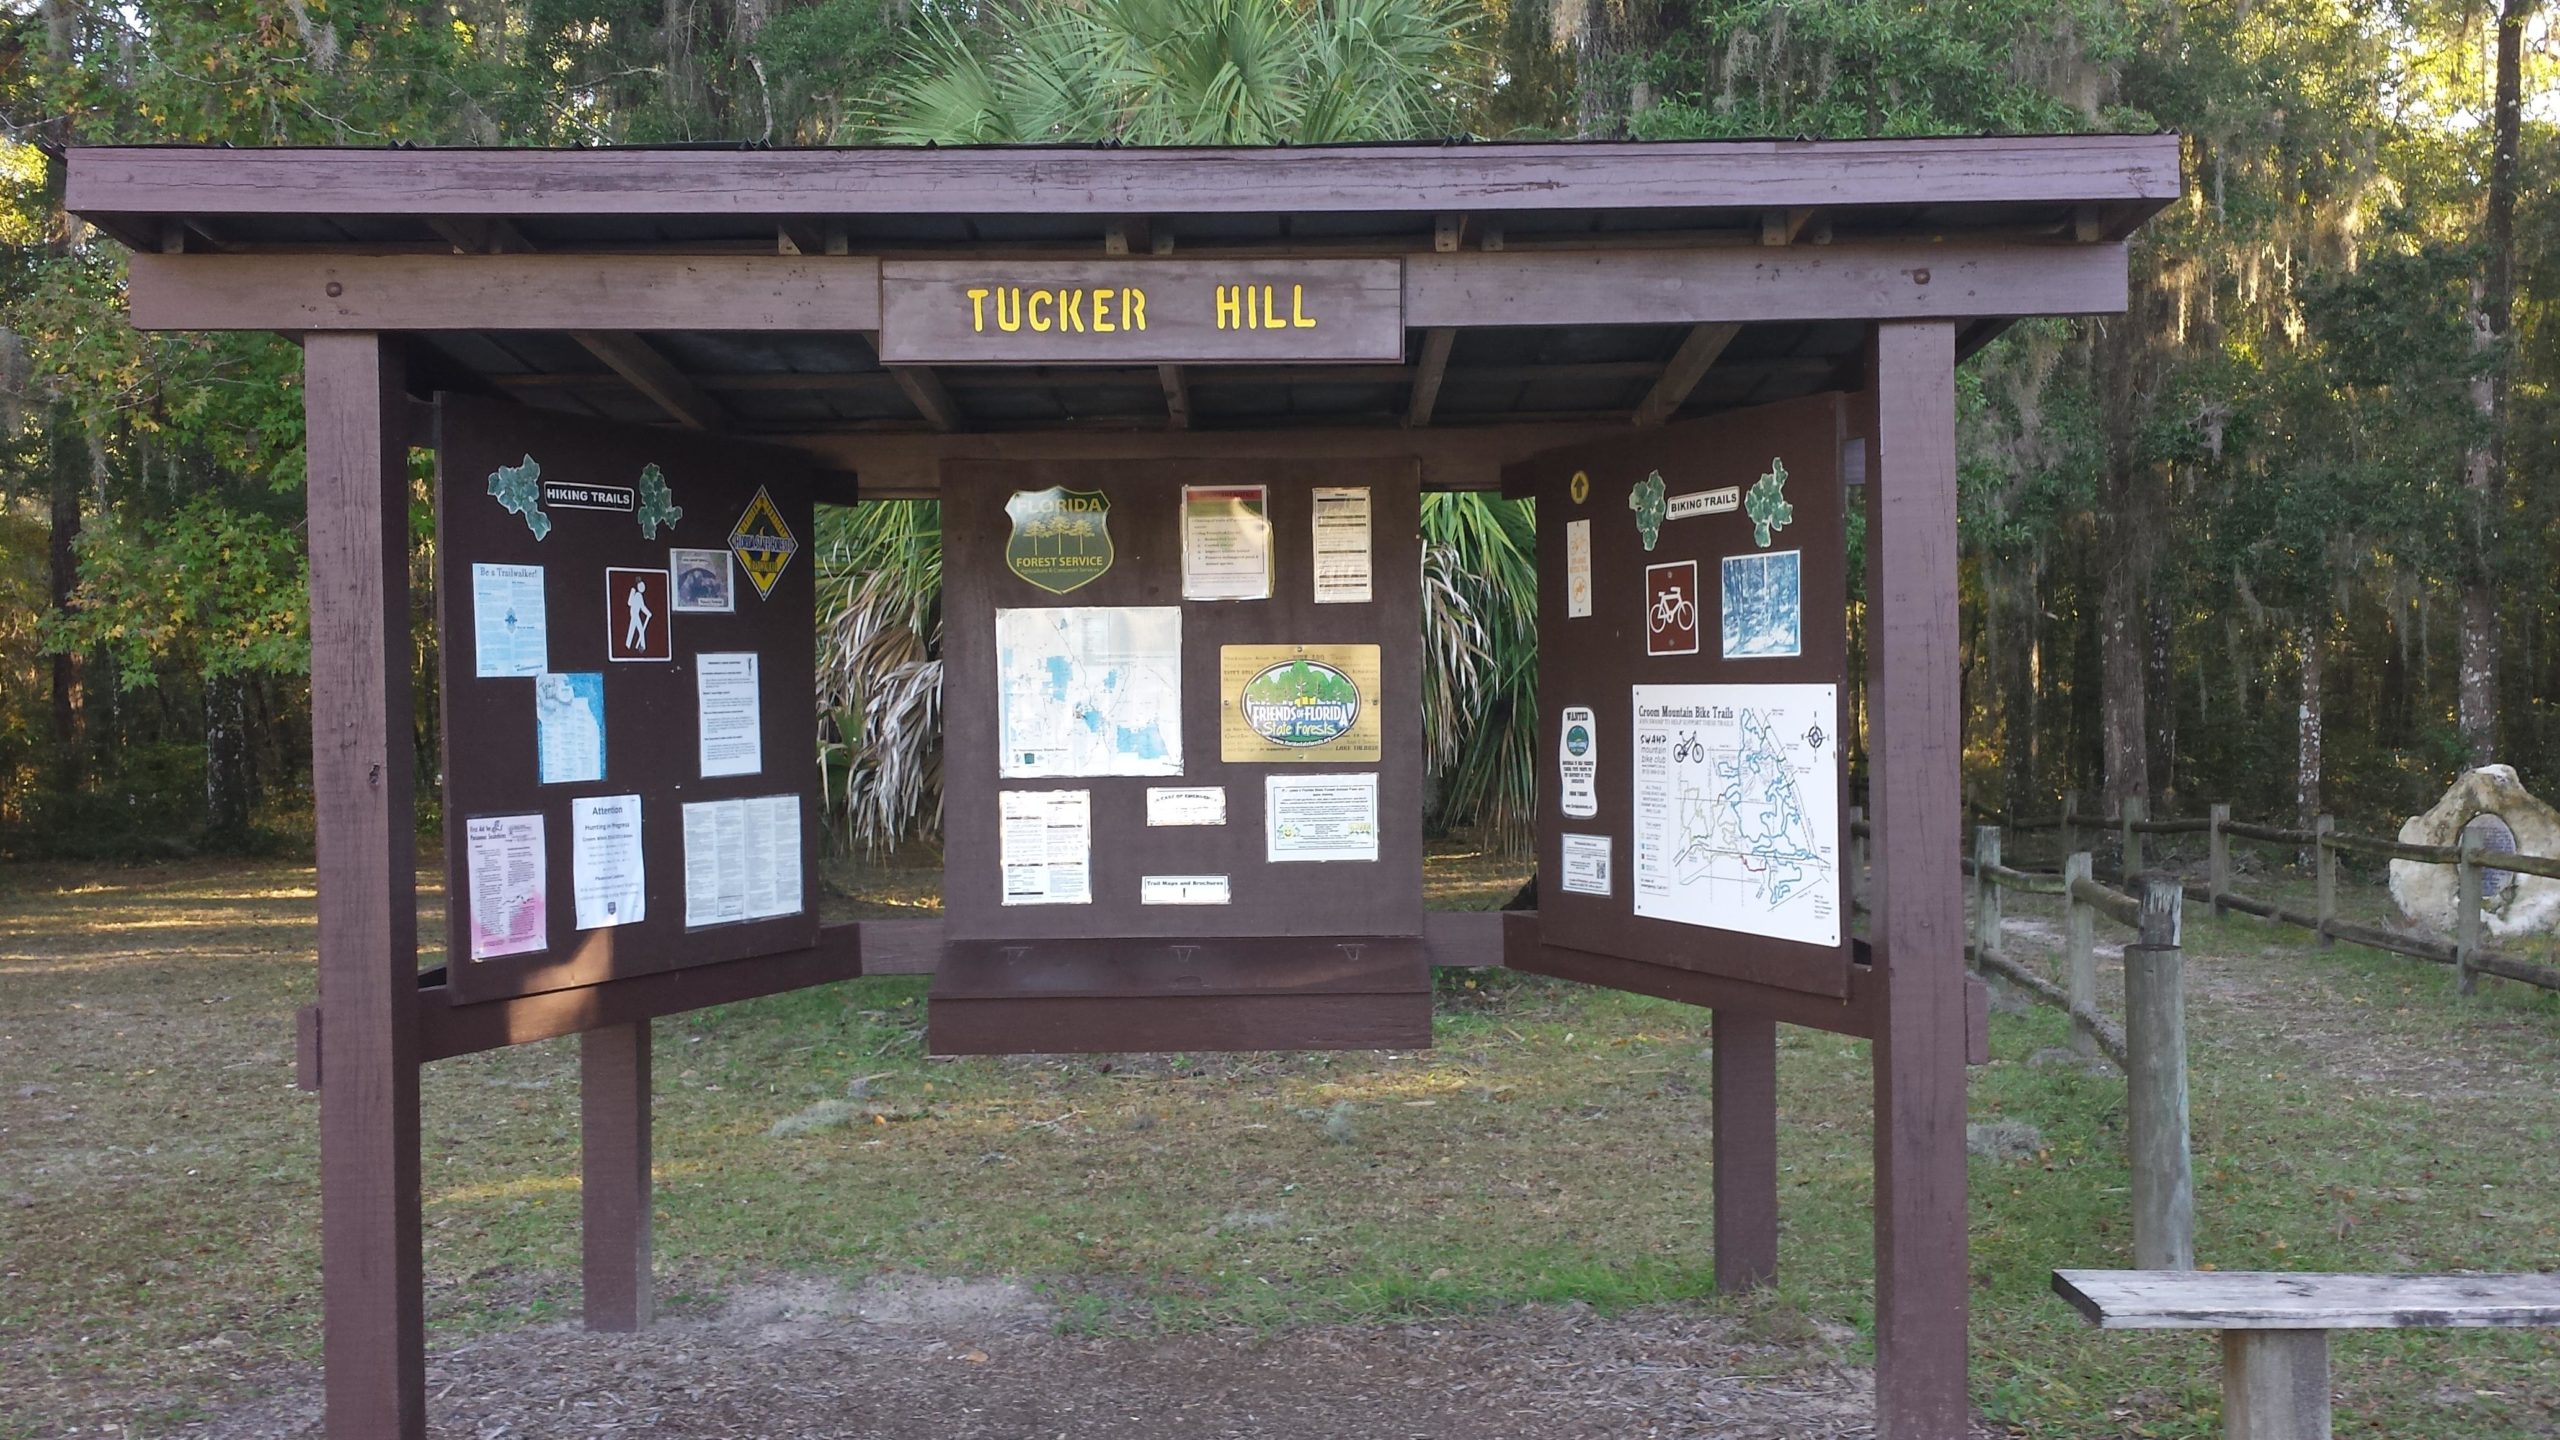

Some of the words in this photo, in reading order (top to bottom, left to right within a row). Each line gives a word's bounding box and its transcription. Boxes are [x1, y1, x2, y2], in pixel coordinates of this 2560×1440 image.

[967, 286, 1146, 333] TUCKER
[1215, 284, 1317, 330] HILL
[547, 488, 588, 501] HIKING
[591, 491, 630, 505] TRAILS
[1671, 499, 1702, 513] BIKING
[1704, 493, 1737, 508] TRAILS
[1016, 498, 1103, 513] FLORIDA
[1016, 557, 1057, 568] FOREST
[1059, 556, 1103, 567] SERVICE
[480, 566, 489, 577] Be
[497, 568, 538, 578] Trailwalker!
[1253, 706, 1296, 727] FRIENDS
[1304, 705, 1349, 727] FLORIDA
[1567, 711, 1588, 721] WANTED
[1638, 705, 1660, 717] Croom
[1661, 705, 1693, 718] Mountain
[1695, 706, 1710, 718] Bike
[1712, 706, 1733, 719] Trails
[1261, 721, 1292, 735] State
[1296, 721, 1337, 736] Forests
[592, 806, 622, 816] Attention
